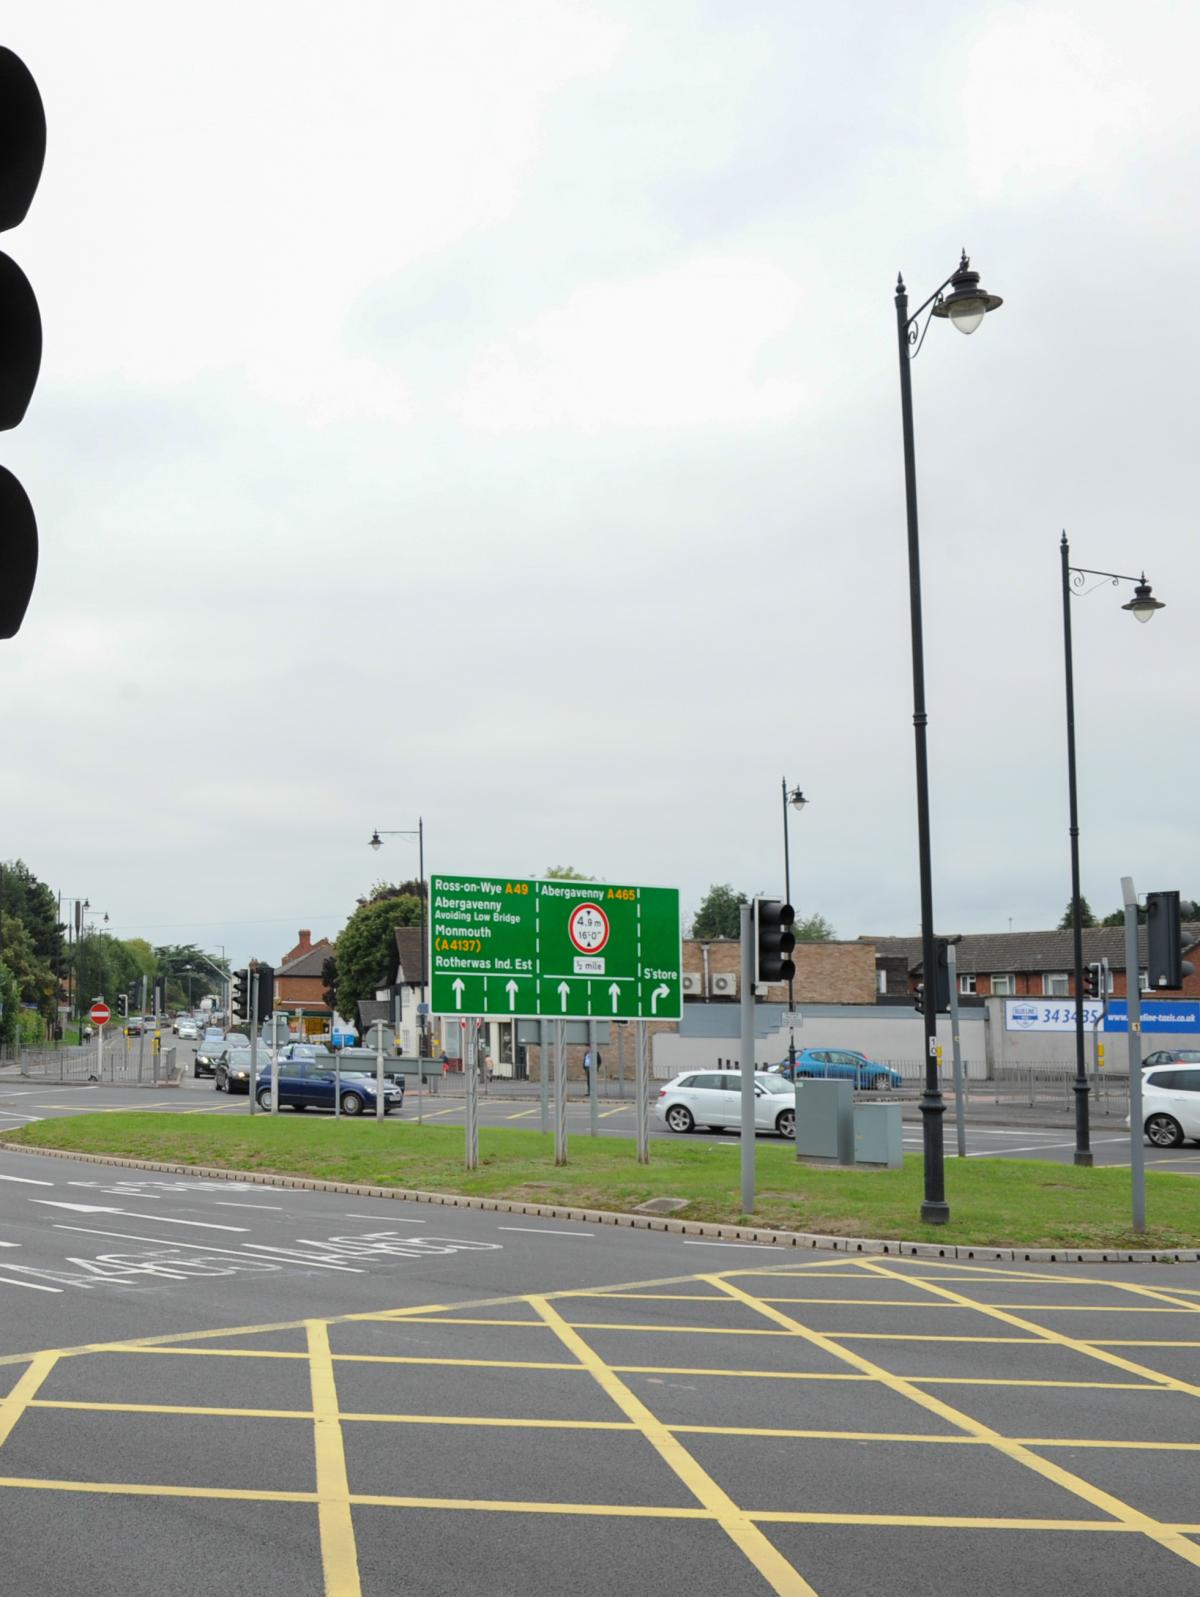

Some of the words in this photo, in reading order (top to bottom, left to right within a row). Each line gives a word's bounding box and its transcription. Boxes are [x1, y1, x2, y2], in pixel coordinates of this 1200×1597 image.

[435, 879, 502, 895] Ross-on-Wye
[505, 883, 529, 895] A49
[541, 884, 604, 901] Abergavenny
[607, 888, 636, 900] A465
[434, 896, 502, 912] Abergavenny
[434, 910, 472, 921] Avoiding
[473, 911, 491, 922] Low
[493, 912, 521, 924] Bridge
[577, 916, 593, 927] 4.9
[435, 924, 492, 938] Monmouth
[434, 937, 482, 952] (A4137)
[435, 955, 491, 968] Rotherwas
[494, 957, 513, 970] Ind.
[515, 959, 533, 970] Est
[584, 961, 602, 971] mile
[643, 968, 678, 980] S'store
[241, 1231, 504, 1264] A465
